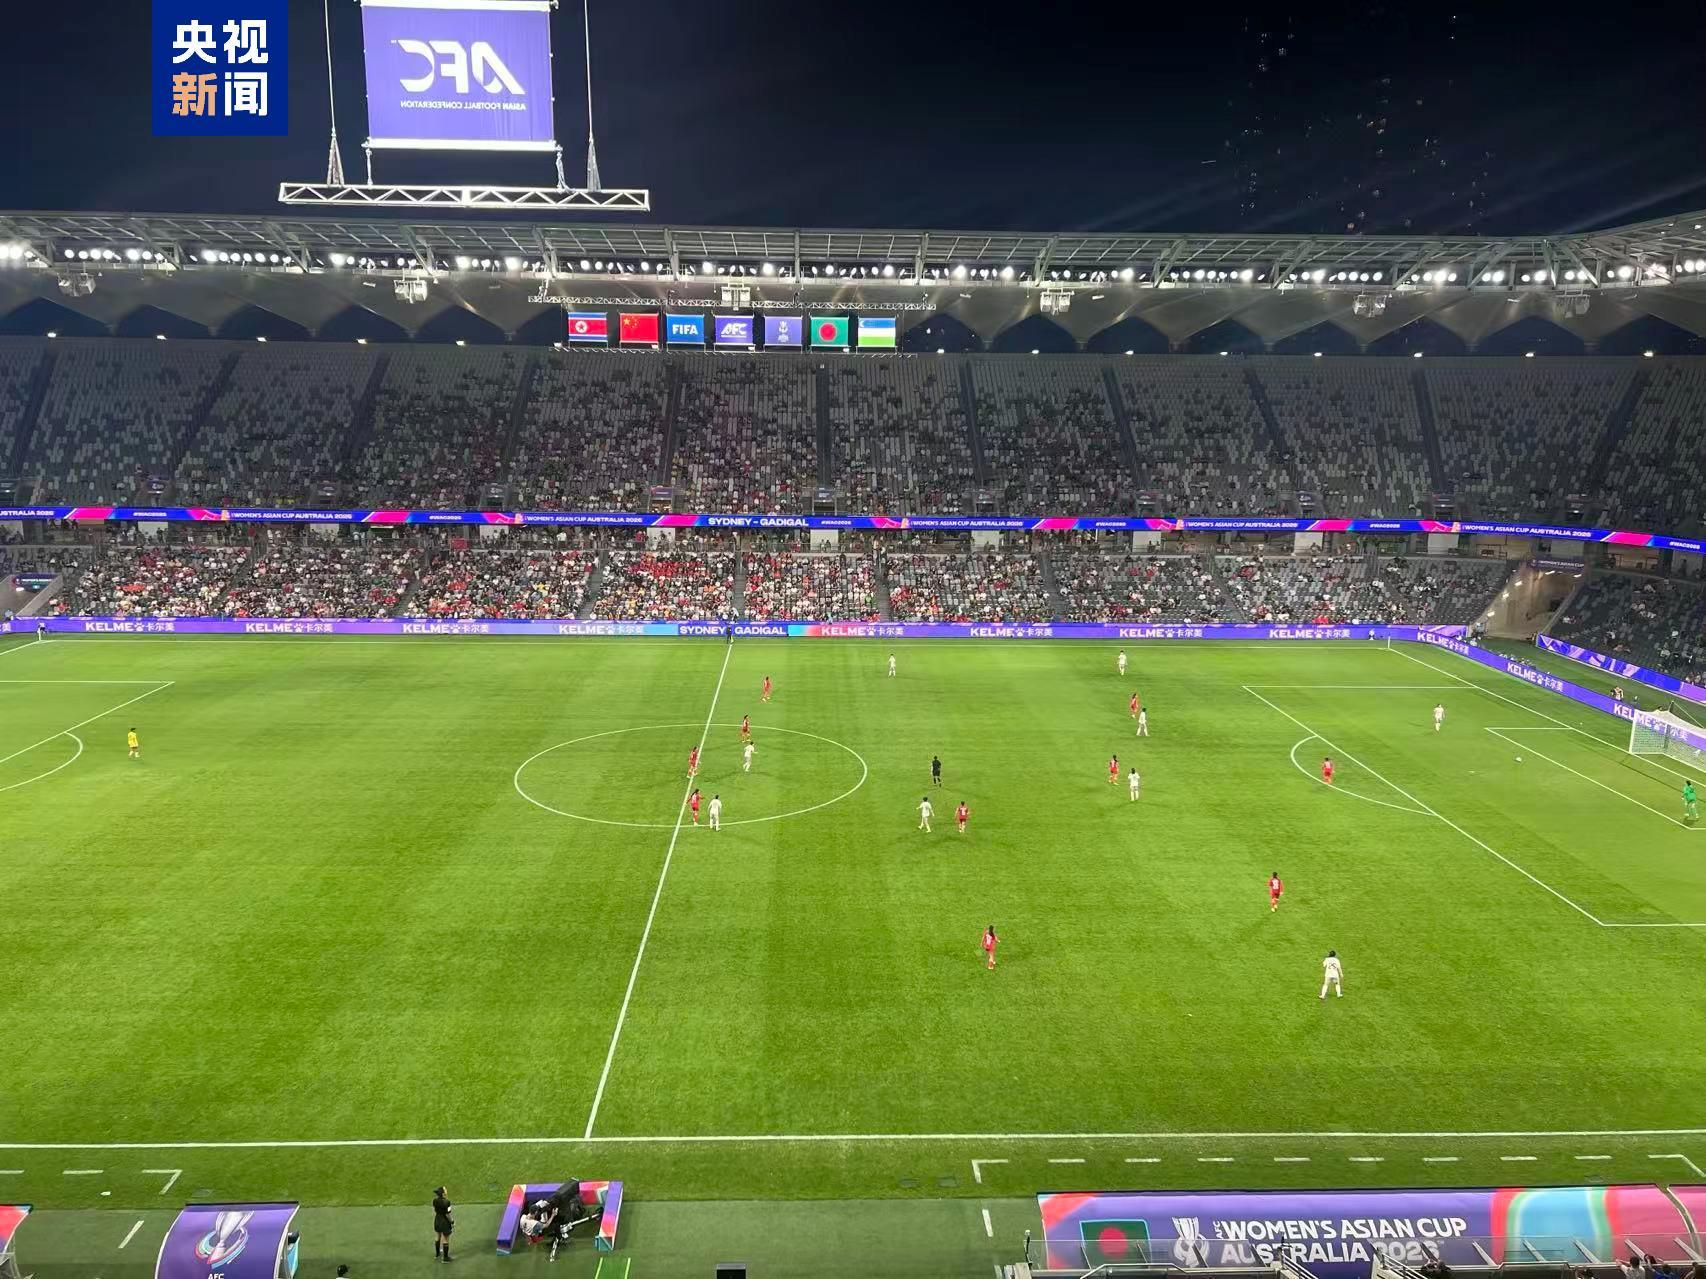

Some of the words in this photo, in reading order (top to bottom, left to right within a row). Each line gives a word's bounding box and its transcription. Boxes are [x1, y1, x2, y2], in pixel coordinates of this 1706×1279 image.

[671, 323, 699, 335] FIFA
[721, 322, 748, 335] AFC
[708, 517, 752, 526] SYDNEY
[760, 518, 809, 527] GADIGAL
[1530, 528, 1571, 536] AUSTRALIA
[85, 622, 134, 632] KELME
[245, 623, 293, 633] KELME
[403, 623, 451, 633] KELME
[461, 623, 489, 633] 卡尔美
[559, 624, 605, 634] KELME
[679, 626, 726, 635] SYDNEY
[734, 625, 787, 635] GADIGAL
[821, 626, 866, 636] KELME
[876, 626, 904, 636] 卡尔美
[970, 628, 1015, 637] KELME
[1026, 627, 1053, 637] 卡尔美
[1119, 628, 1164, 638] KELME
[1176, 628, 1203, 638] 卡尔美
[1269, 629, 1312, 638] KELME
[1325, 628, 1350, 638] 卡尔美
[1417, 632, 1449, 648] KELME
[1507, 662, 1537, 682] KELME
[1614, 703, 1652, 728] KELME
[1213, 1220, 1224, 1240] AFC
[1221, 1219, 1336, 1240] WOMEN'S
[1341, 1218, 1416, 1239] ASIAN
[1416, 1217, 1467, 1238] CUP
